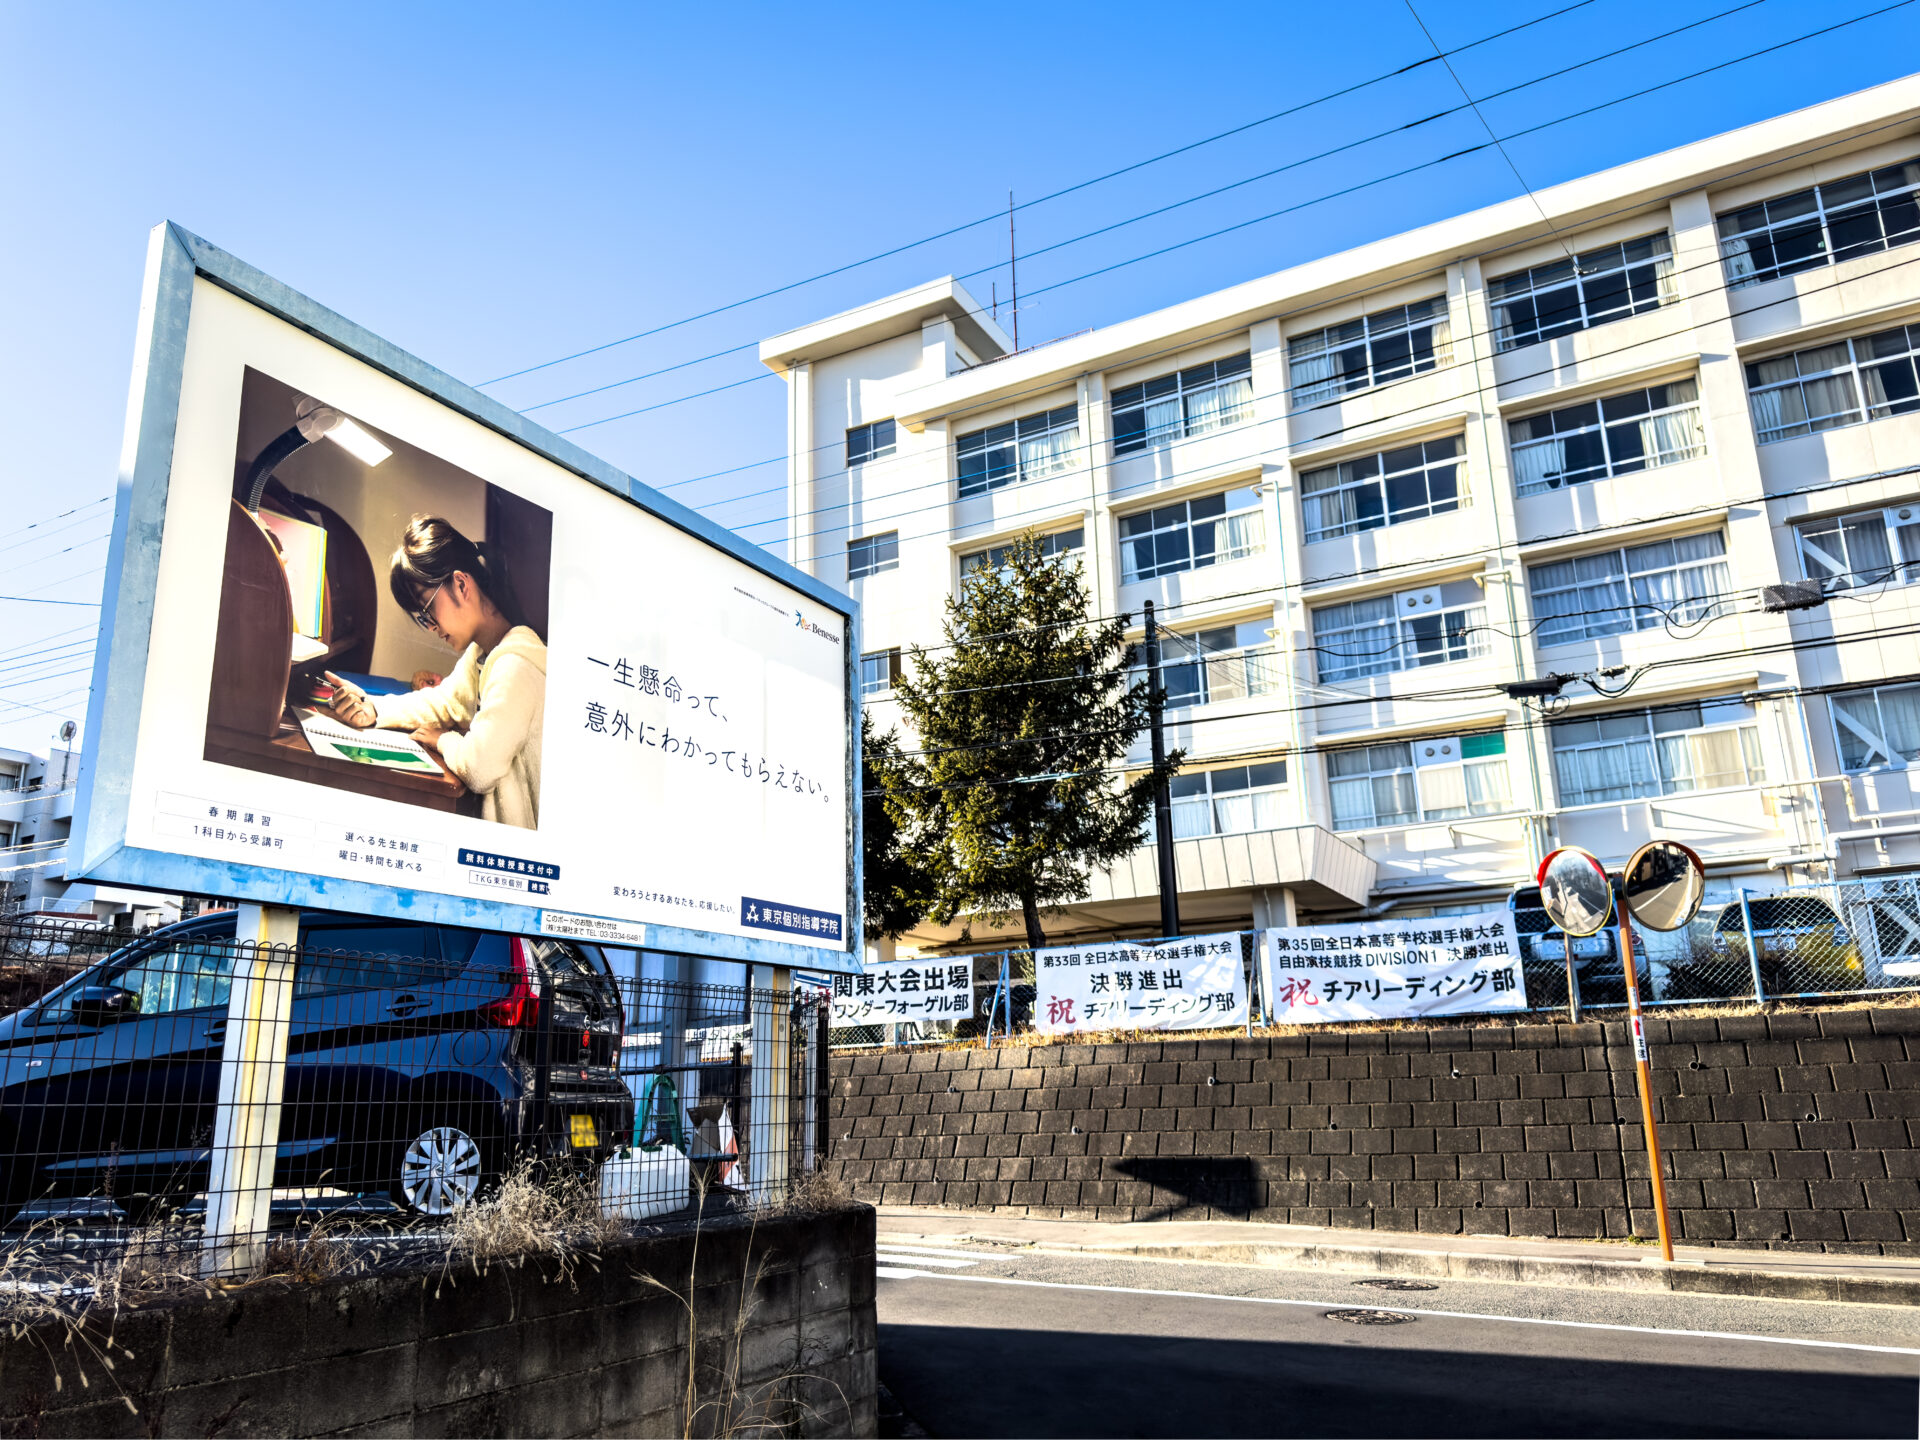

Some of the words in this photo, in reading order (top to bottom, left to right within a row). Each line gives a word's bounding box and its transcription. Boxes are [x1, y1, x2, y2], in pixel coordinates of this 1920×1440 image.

[812, 623, 840, 644] Benesse
[587, 656, 728, 722] 一生懸命って、
[584, 701, 829, 803] 意外にわかってもらえない。
[208, 806, 271, 827] 春期講習
[193, 825, 284, 849] 1科目から受講可
[344, 831, 420, 853] 選べる先生制度
[465, 853, 554, 876] 無料体験授業受付中
[762, 907, 839, 935] 東京個別指導学院
[1277, 922, 1505, 951] 第35回全日本高等学校選手権大会
[1447, 941, 1510, 961] 決勝進出
[834, 965, 970, 998] 関東大会出場
[1279, 976, 1319, 1008] 祝
[1322, 967, 1516, 1002] チアリーディング部
[834, 993, 969, 1019] ワンダーフォーゲル部
[1046, 995, 1077, 1025] 祝
